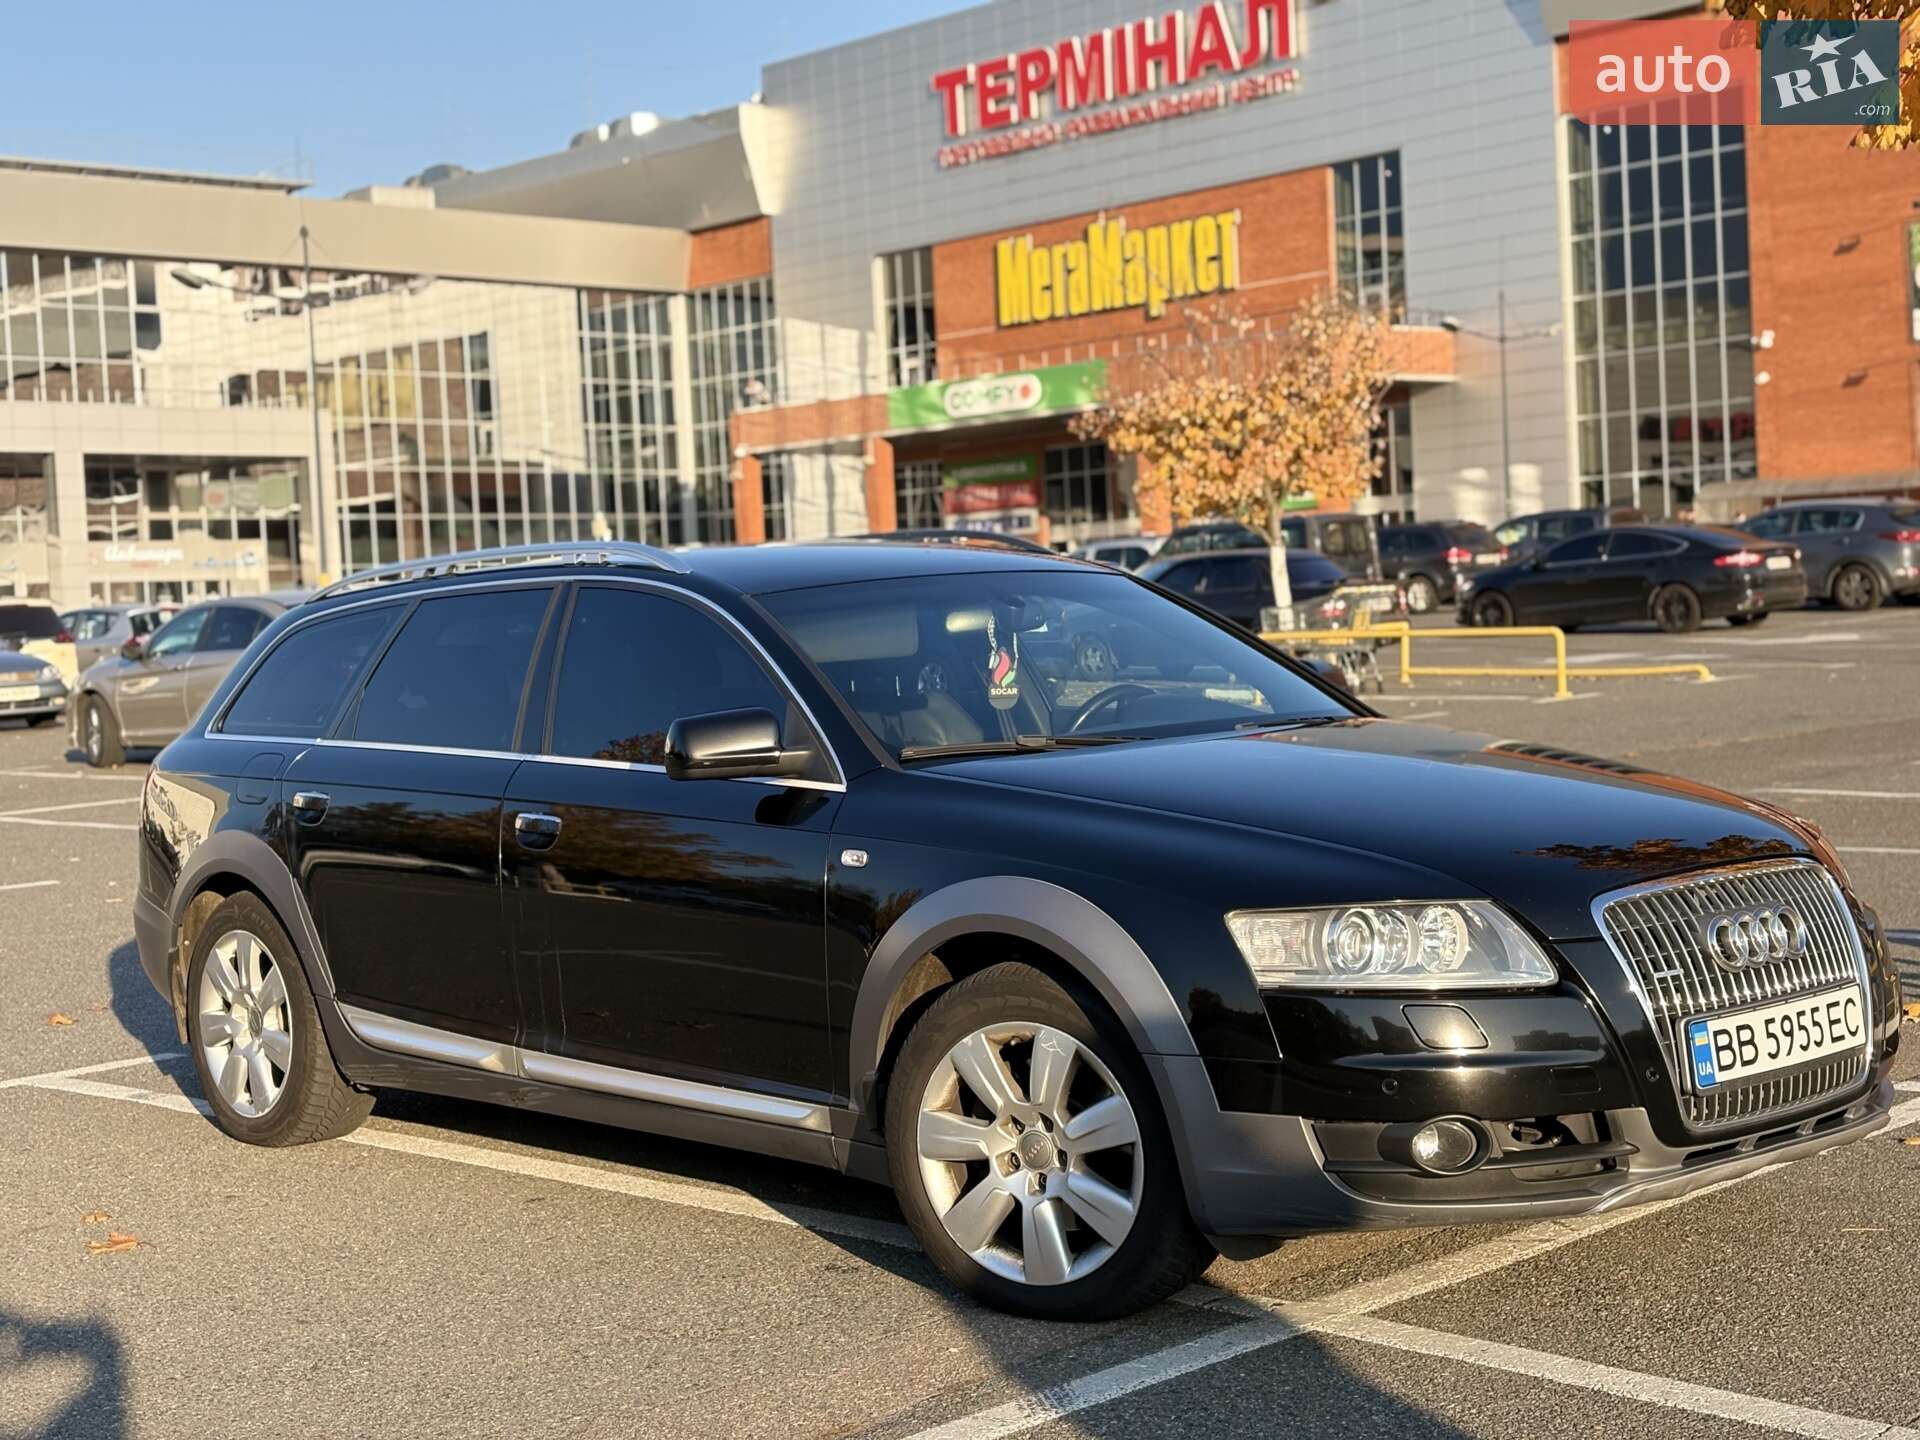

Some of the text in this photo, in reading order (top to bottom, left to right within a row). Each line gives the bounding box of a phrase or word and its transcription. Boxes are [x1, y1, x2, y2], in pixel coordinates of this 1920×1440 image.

[931, 0, 1300, 137] ТЕРМІНАЛ
[995, 208, 1242, 325] МегаМаркет
[991, 687, 1018, 695] SOCAR
[1698, 1062, 1713, 1076] UA
[1713, 1022, 1760, 1073] BB
